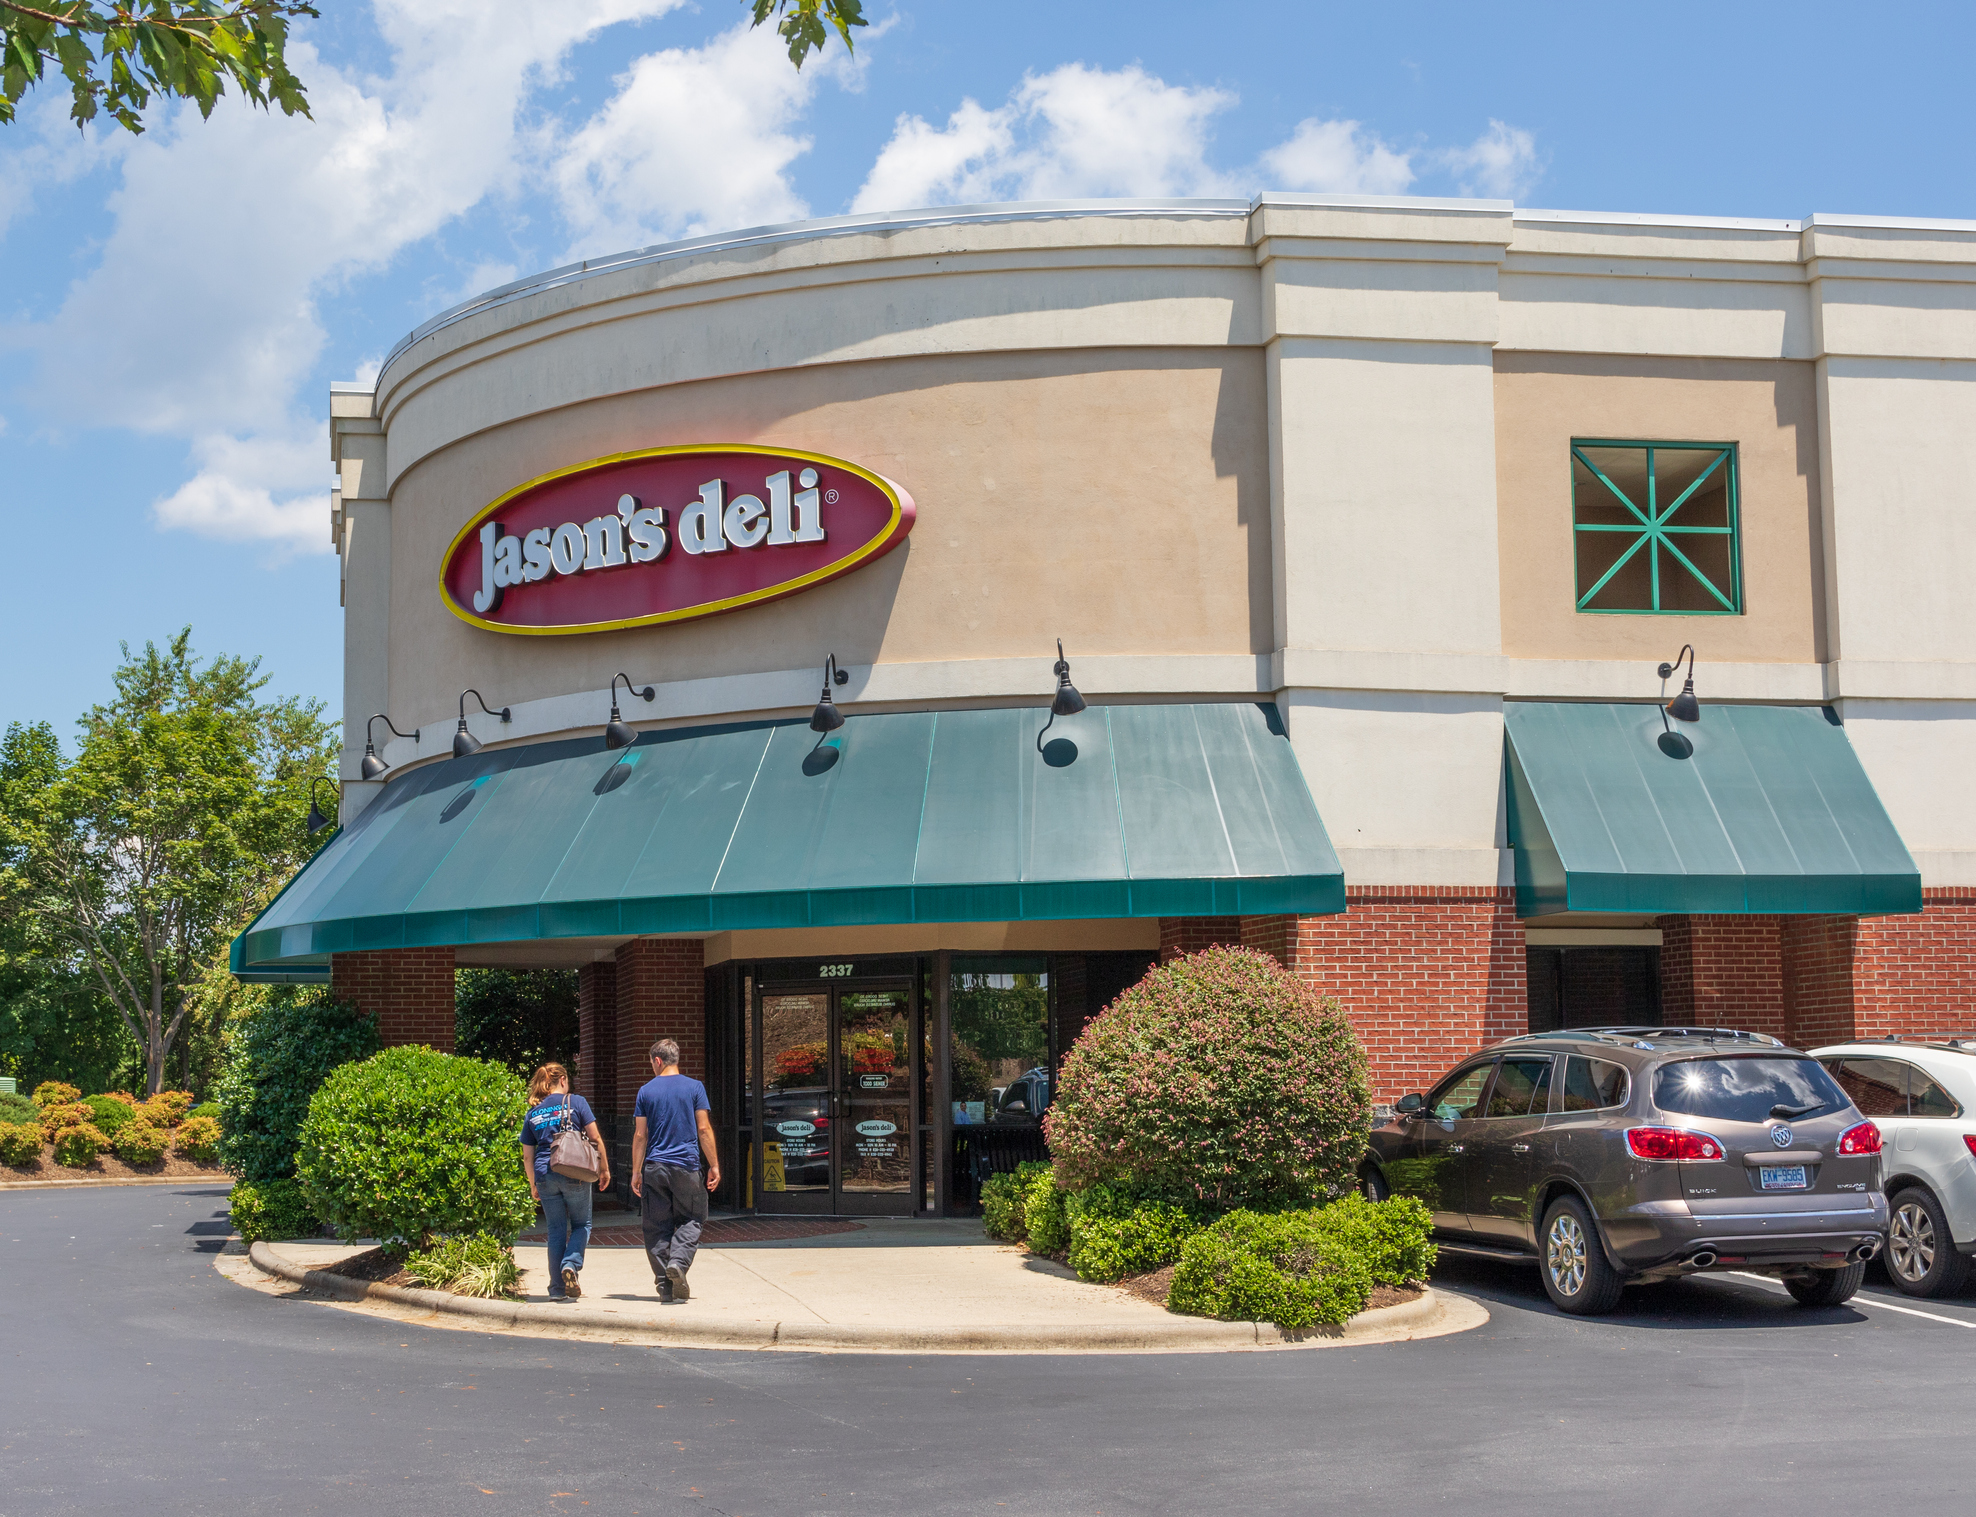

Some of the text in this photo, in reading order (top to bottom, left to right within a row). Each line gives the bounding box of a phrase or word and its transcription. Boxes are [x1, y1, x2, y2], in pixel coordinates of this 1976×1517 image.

[473, 467, 826, 613] Jason's deli
[820, 964, 853, 977] 2337
[861, 1124, 880, 1132] Jason's
[1762, 1168, 1803, 1182] EKW-9585
